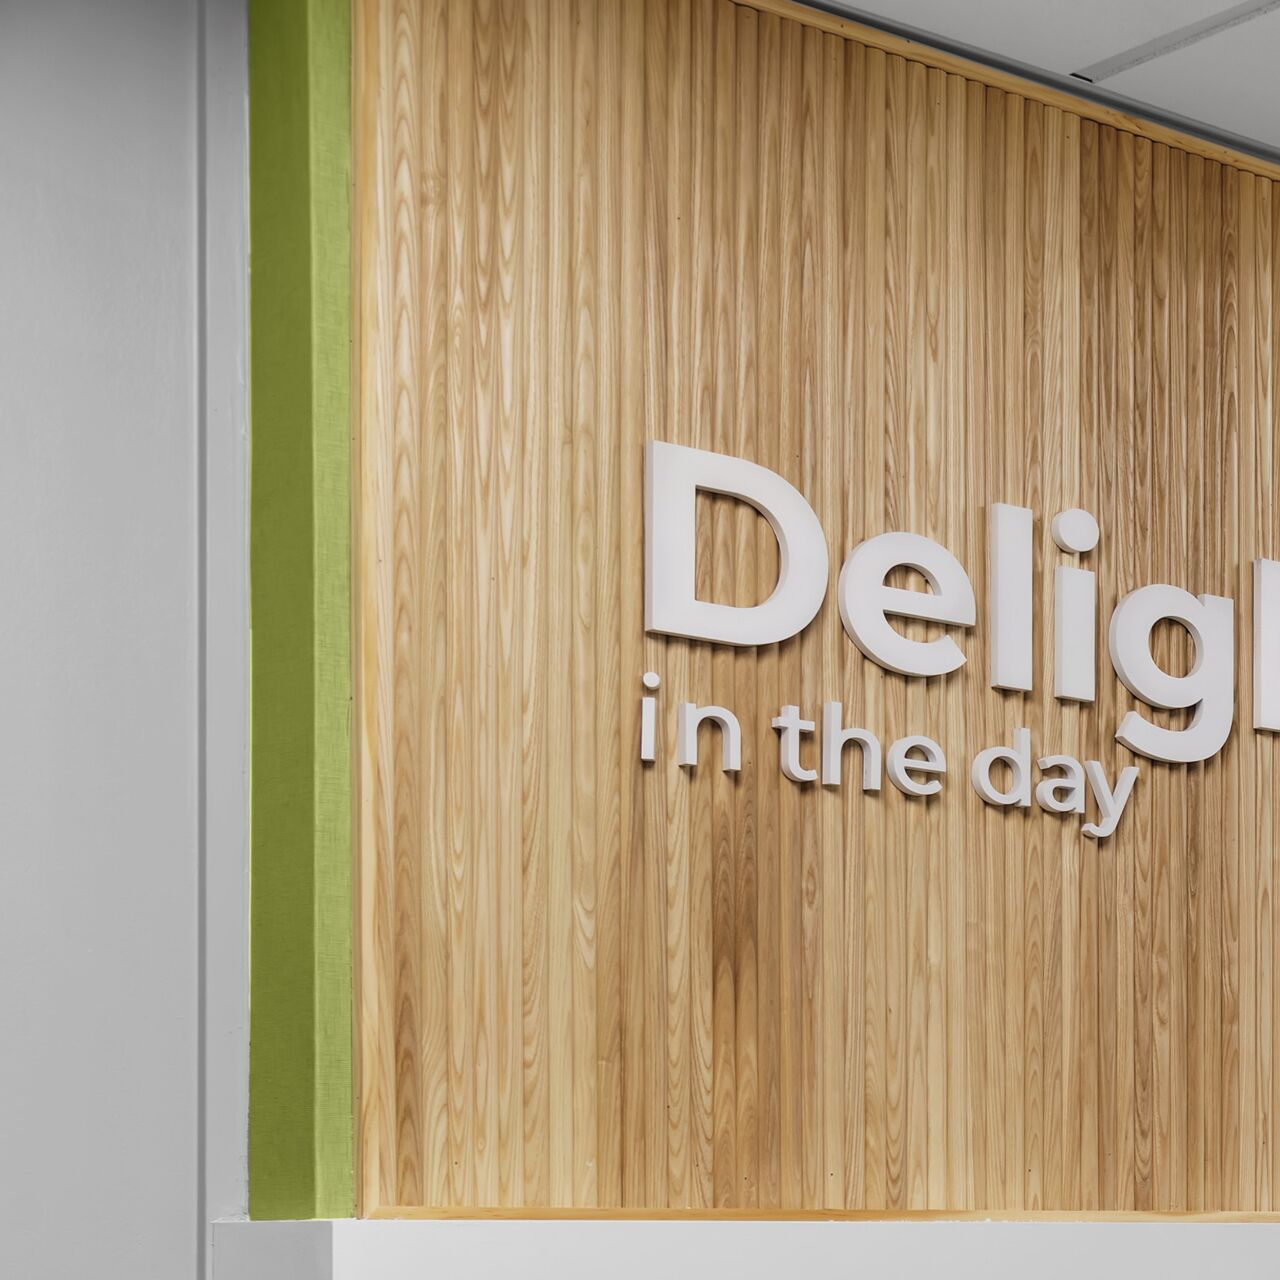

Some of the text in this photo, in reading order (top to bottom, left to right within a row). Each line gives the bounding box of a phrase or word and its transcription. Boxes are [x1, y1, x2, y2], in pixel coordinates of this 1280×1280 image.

[641, 672, 1140, 839] in the day
